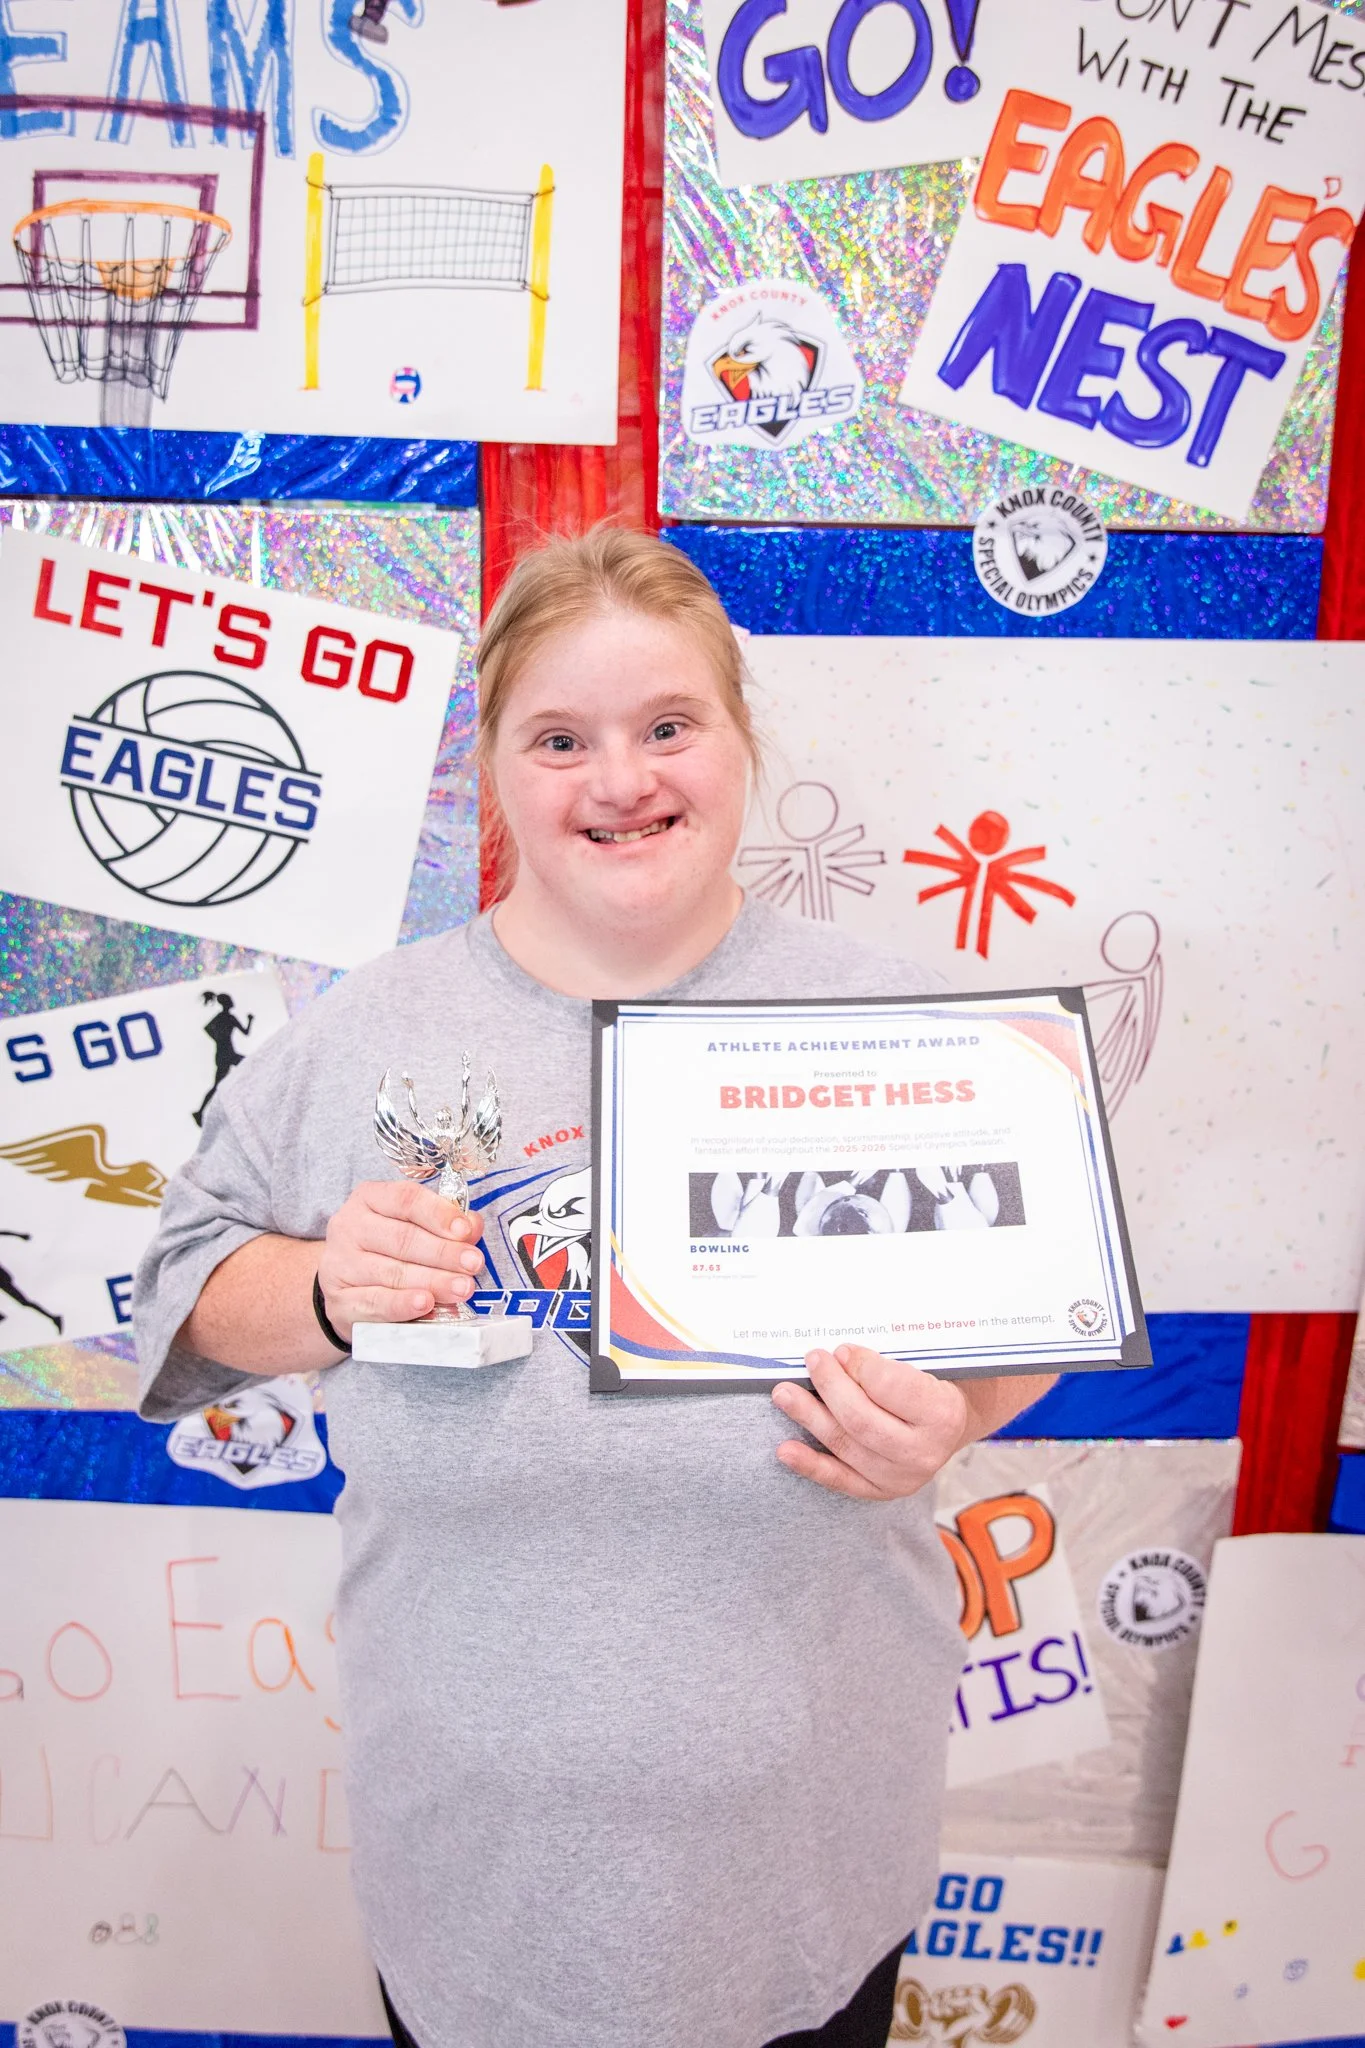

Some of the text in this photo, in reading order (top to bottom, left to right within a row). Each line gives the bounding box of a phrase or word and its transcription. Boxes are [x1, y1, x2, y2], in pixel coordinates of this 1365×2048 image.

[717, 0, 980, 138] GO!
[1252, 5, 1365, 97] MES
[1078, 26, 1307, 144] WITH THE
[974, 88, 1355, 342] EAGLE'S
[711, 289, 809, 321] KNOX COUNTY
[938, 263, 1286, 468] NEST
[689, 384, 855, 434] EAGLES
[996, 488, 1103, 542] KNOX COUNTY
[978, 536, 1094, 611] SPECIAL OLYMPICS
[32, 557, 415, 704] LET'S GO
[60, 724, 322, 832] EAGLES
[72, 1011, 164, 1071] GO
[706, 1035, 980, 1052] ATHLETE ACHIEVEMENT AWARD
[719, 1079, 976, 1109] BRIDGET HESS
[813, 1070, 864, 1078] Presented
[522, 1124, 585, 1158] KNOX
[689, 1244, 750, 1254] BOWLING
[692, 1264, 721, 1272] 87.63
[733, 1329, 749, 1338] Let
[752, 1330, 767, 1338] me
[770, 1329, 791, 1338] win.
[794, 1328, 811, 1337] But
[814, 1327, 820, 1336] if
[828, 1326, 865, 1336] cannot
[867, 1324, 889, 1334] win,
[891, 1322, 905, 1332] let
[908, 1323, 925, 1331] me
[928, 1320, 942, 1330] be
[944, 1319, 976, 1329] brave
[978, 1317, 989, 1327] in
[991, 1316, 1008, 1326] the
[1010, 1314, 1055, 1325] attempt.
[1068, 1299, 1104, 1313] KNOX COUNTY
[174, 1435, 323, 1472] EAGLES
[934, 1872, 1004, 1914] GO
